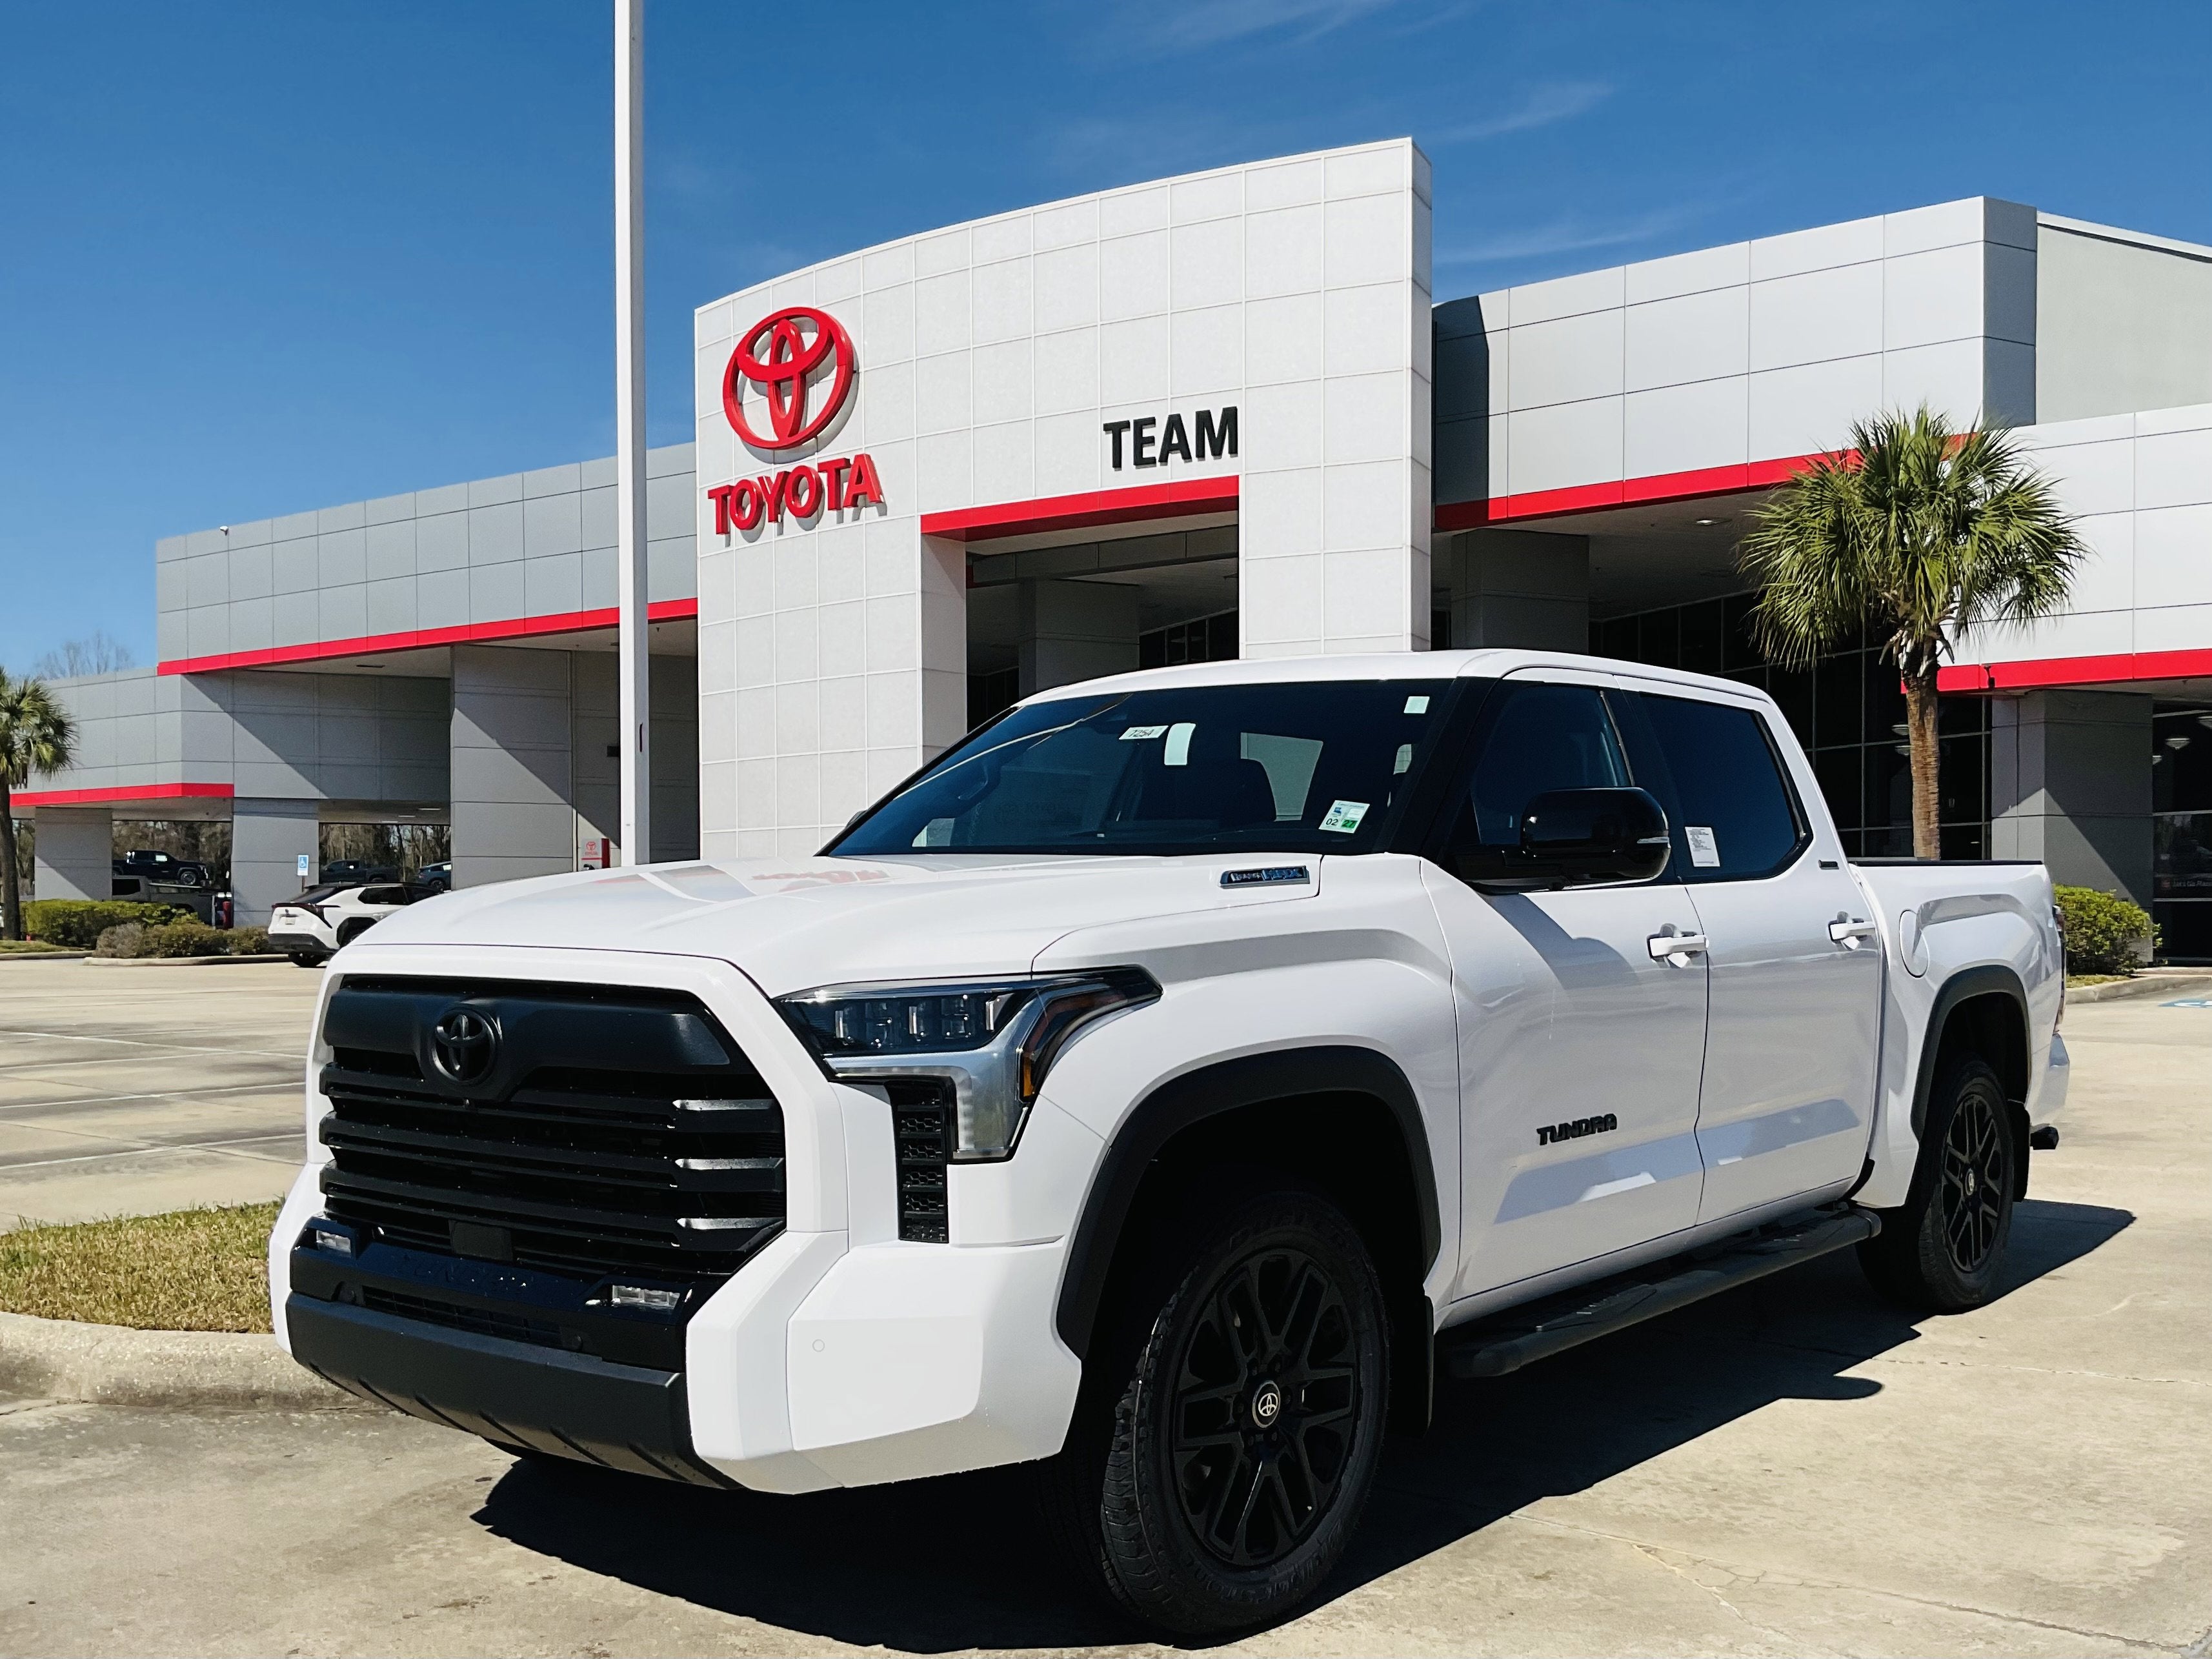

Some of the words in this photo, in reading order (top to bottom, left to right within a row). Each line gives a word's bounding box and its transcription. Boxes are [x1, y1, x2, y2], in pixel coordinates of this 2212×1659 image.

[1103, 406, 1238, 471] TEAM
[707, 453, 884, 536] TOYOTA
[1325, 818, 1338, 826] 02
[1342, 819, 1357, 828] 27
[1536, 1113, 1618, 1146] TUNDRA
